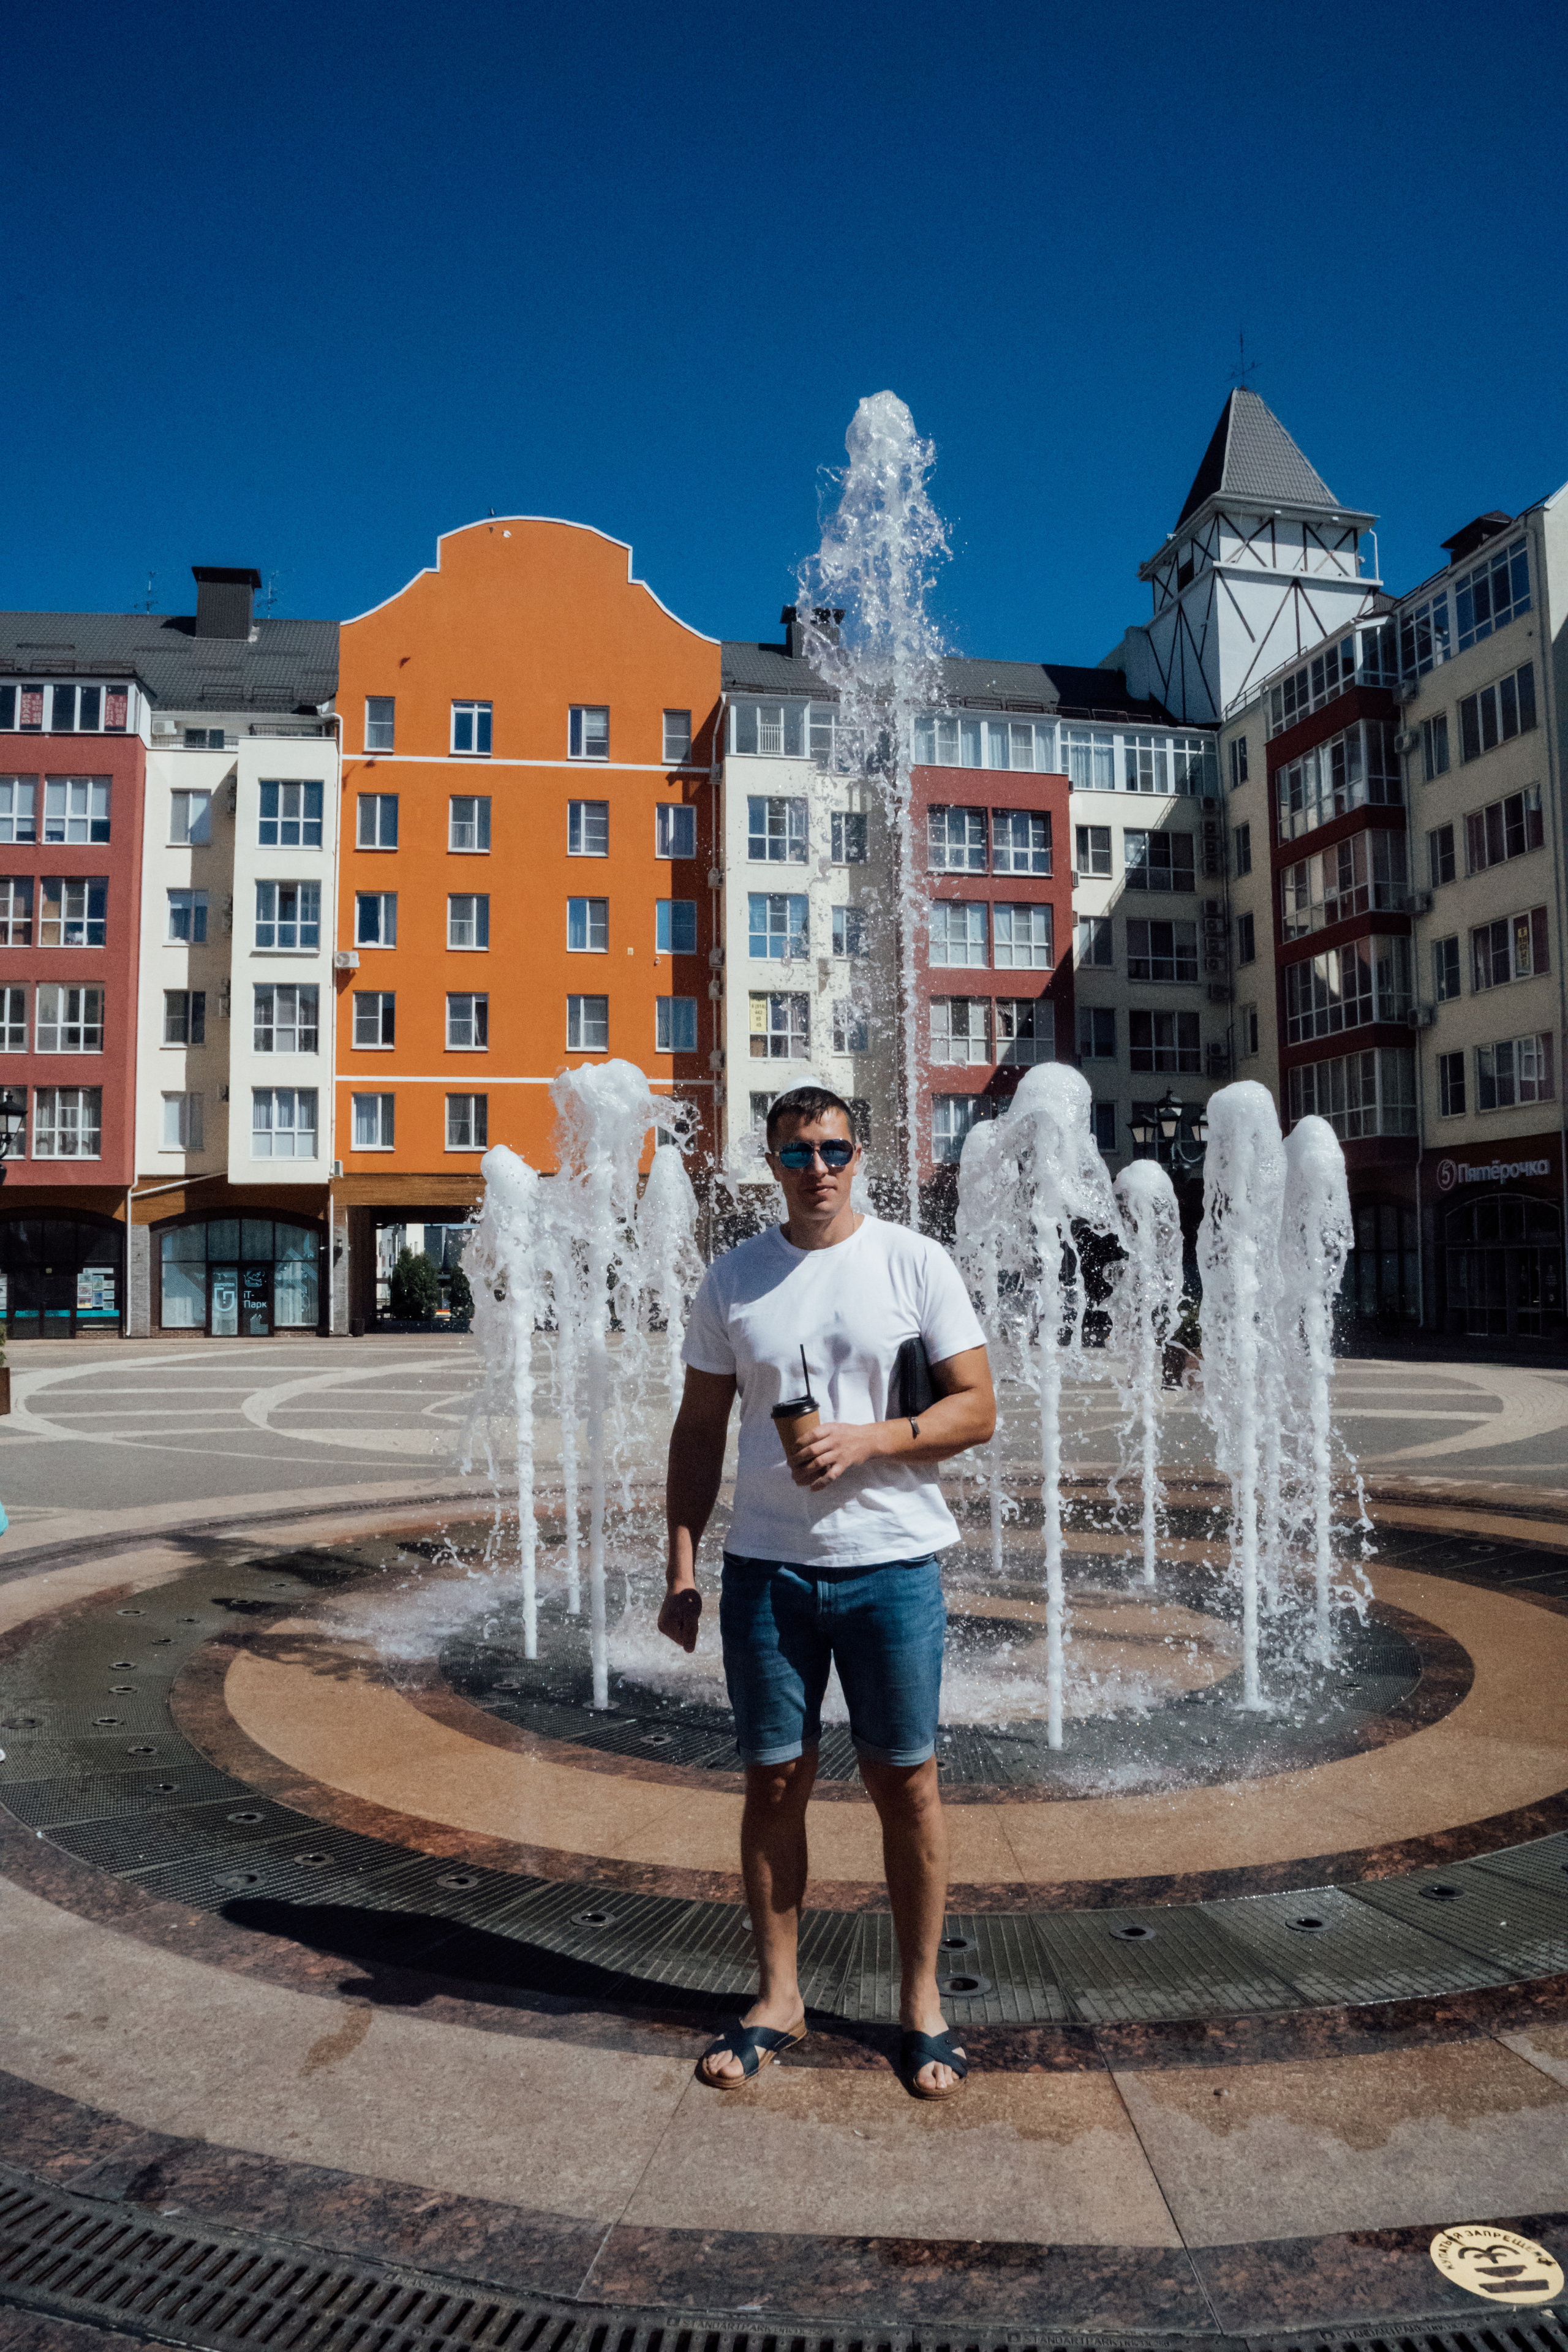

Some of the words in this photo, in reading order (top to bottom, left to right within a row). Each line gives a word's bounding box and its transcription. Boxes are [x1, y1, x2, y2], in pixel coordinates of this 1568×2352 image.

[1458, 1159, 1550, 1185] Пятёрочка
[244, 1300, 267, 1310] Парк
[1438, 2232, 1464, 2270] КУПАТЬЯ
